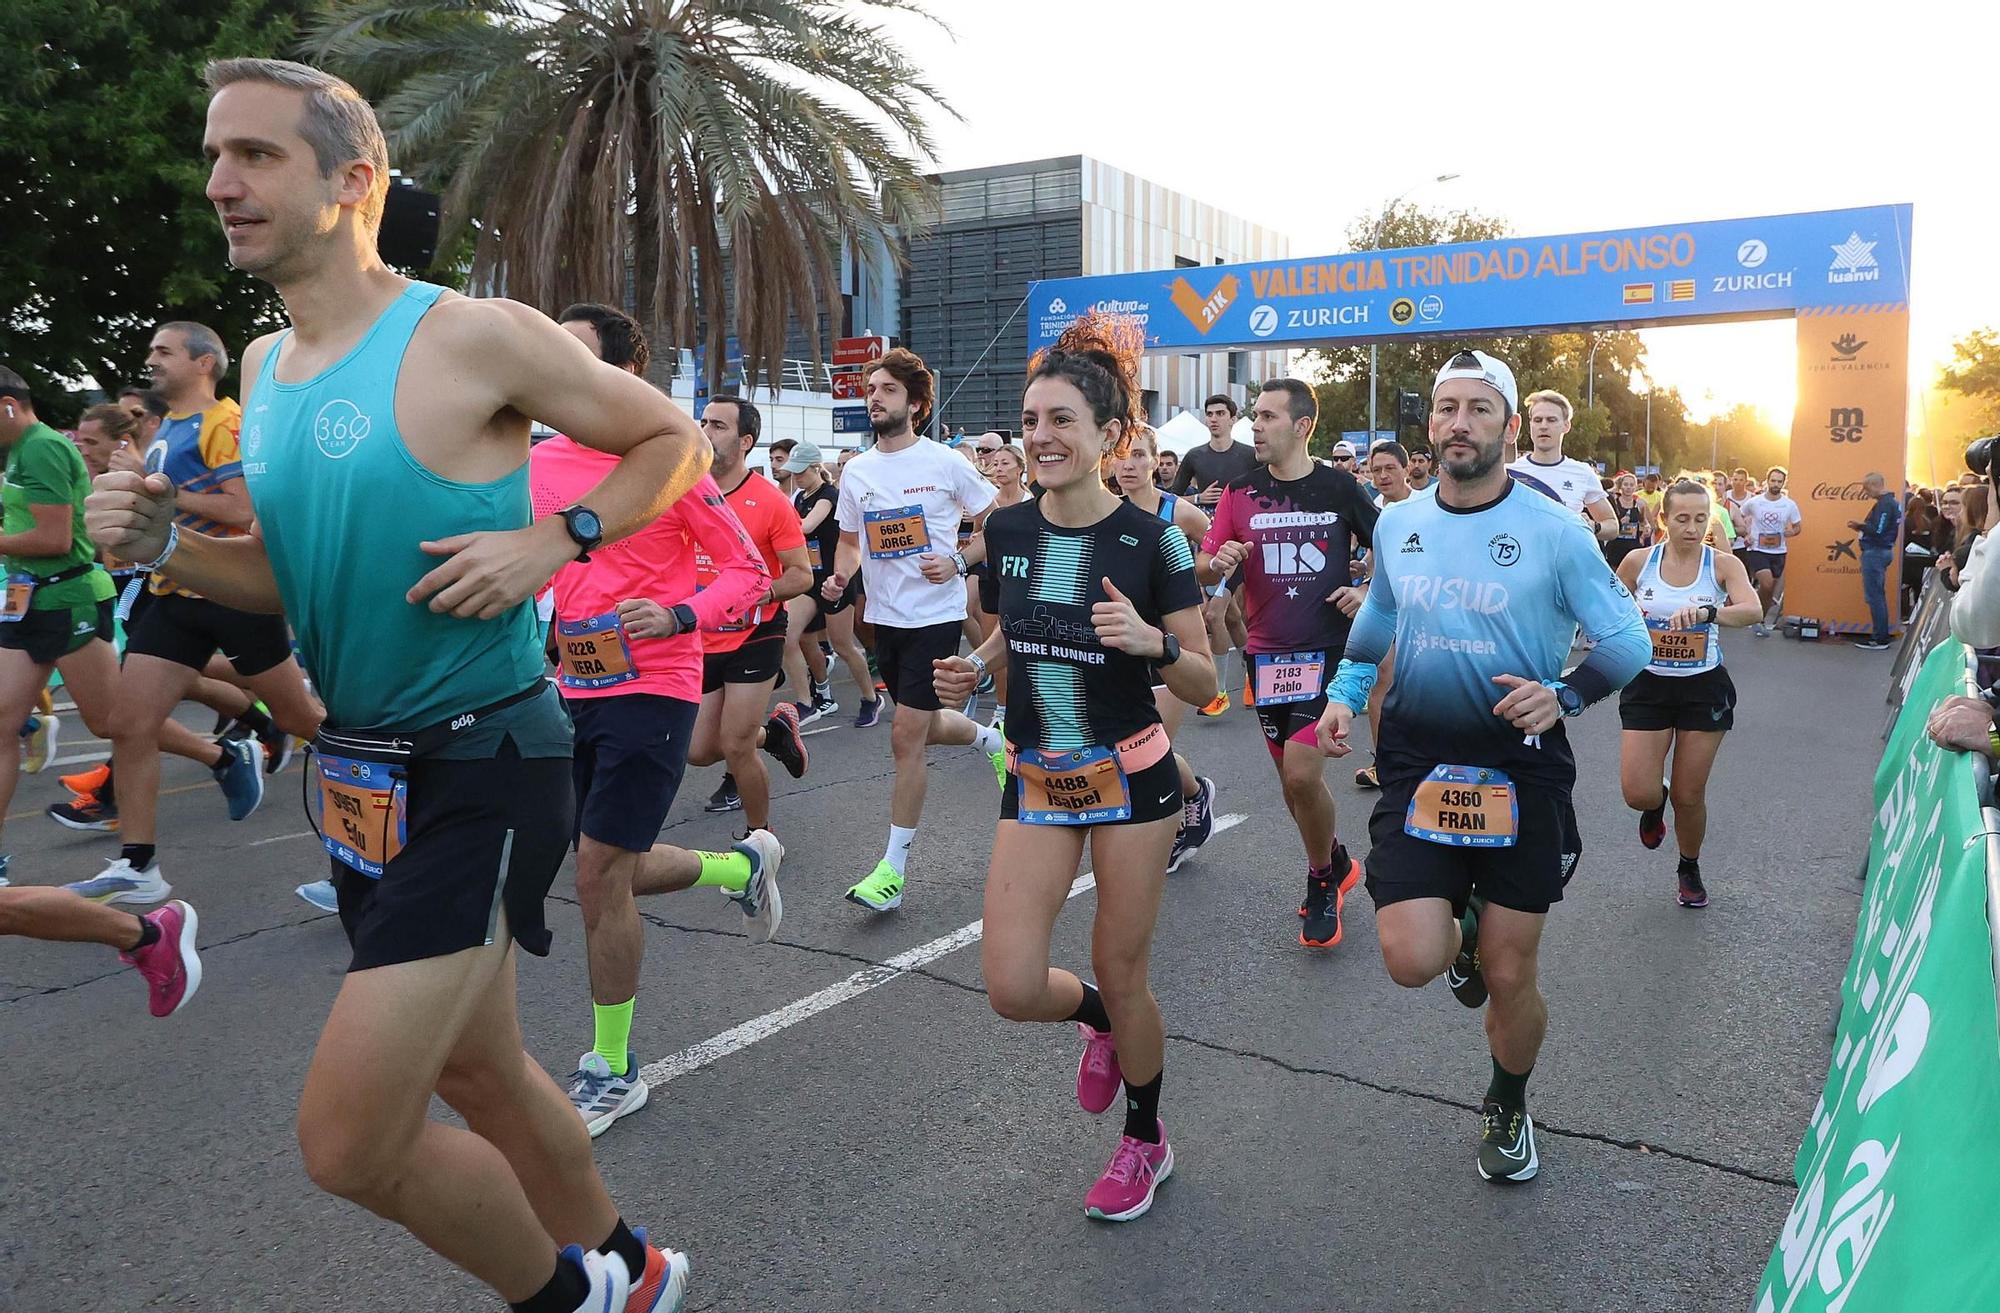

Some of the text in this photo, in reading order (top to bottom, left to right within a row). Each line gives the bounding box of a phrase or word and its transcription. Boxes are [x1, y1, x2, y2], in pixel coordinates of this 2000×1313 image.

[1249, 231, 1696, 299] VALENCIA TRINIDAD ALFONSO
[1713, 272, 1793, 293] ZURICH
[1097, 300, 1137, 313] Cultura
[1201, 289, 1229, 323] 21K
[1287, 305, 1369, 328] ZURICH
[903, 485, 937, 495] MAPFRE
[880, 522, 906, 535] 6683
[1261, 531, 1329, 541] ALZIRA
[880, 535, 914, 550] JORGE
[1497, 543, 1516, 559] TS
[1001, 555, 1029, 579] FR
[1398, 575, 1509, 615] TRISUD
[567, 640, 597, 656] 4228
[1660, 635, 1688, 646] 4374
[1051, 645, 1105, 665] RUNNER
[1653, 647, 1695, 659] REBECA
[571, 659, 607, 675] VERA
[1276, 667, 1302, 680] 2183
[1273, 681, 1302, 694] Pablo
[451, 713, 477, 731] edp
[1120, 727, 1160, 753] LURBEL
[1045, 775, 1089, 792] 4488
[1047, 790, 1102, 810] Isabel
[1441, 789, 1482, 808] 4360
[1438, 811, 1486, 831] FRAN
